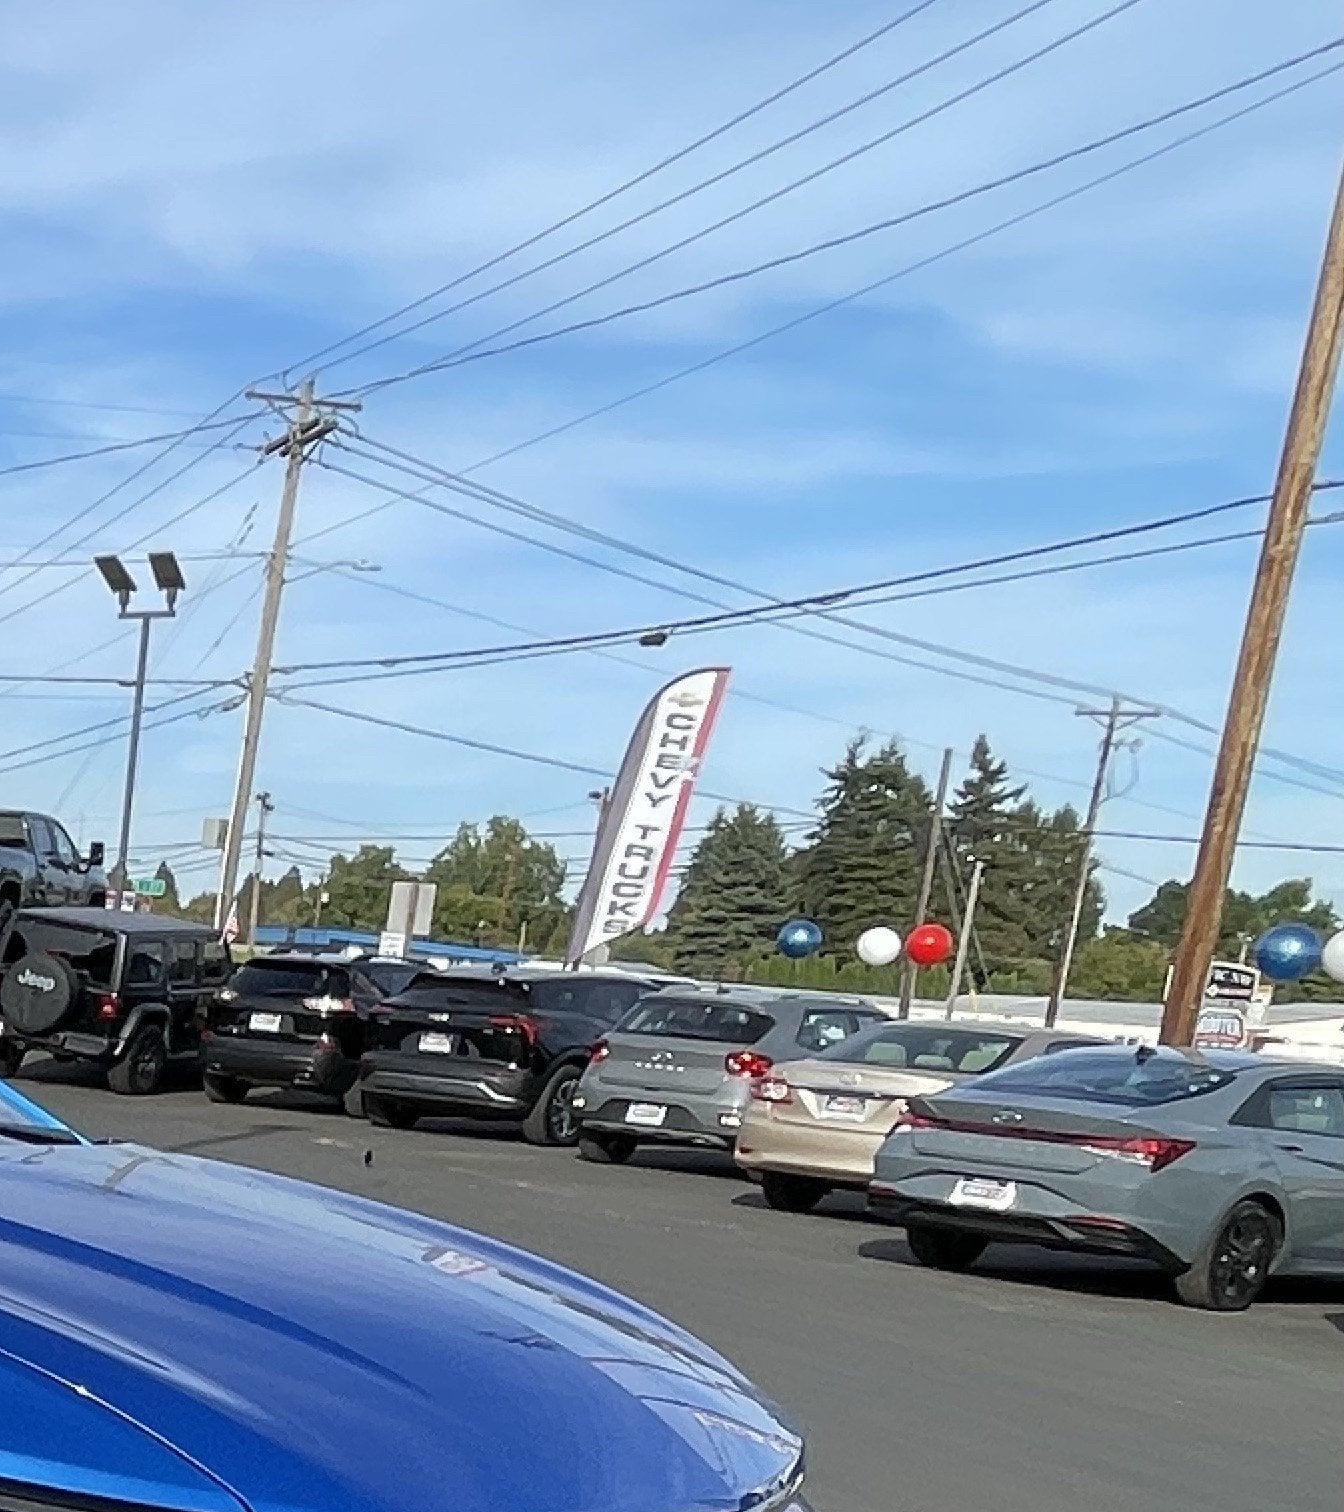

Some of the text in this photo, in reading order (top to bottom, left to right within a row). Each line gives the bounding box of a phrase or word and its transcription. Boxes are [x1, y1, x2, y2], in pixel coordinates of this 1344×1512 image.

[602, 712, 698, 934] CHEVY TRUCKS
[17, 968, 56, 993] Jeep
